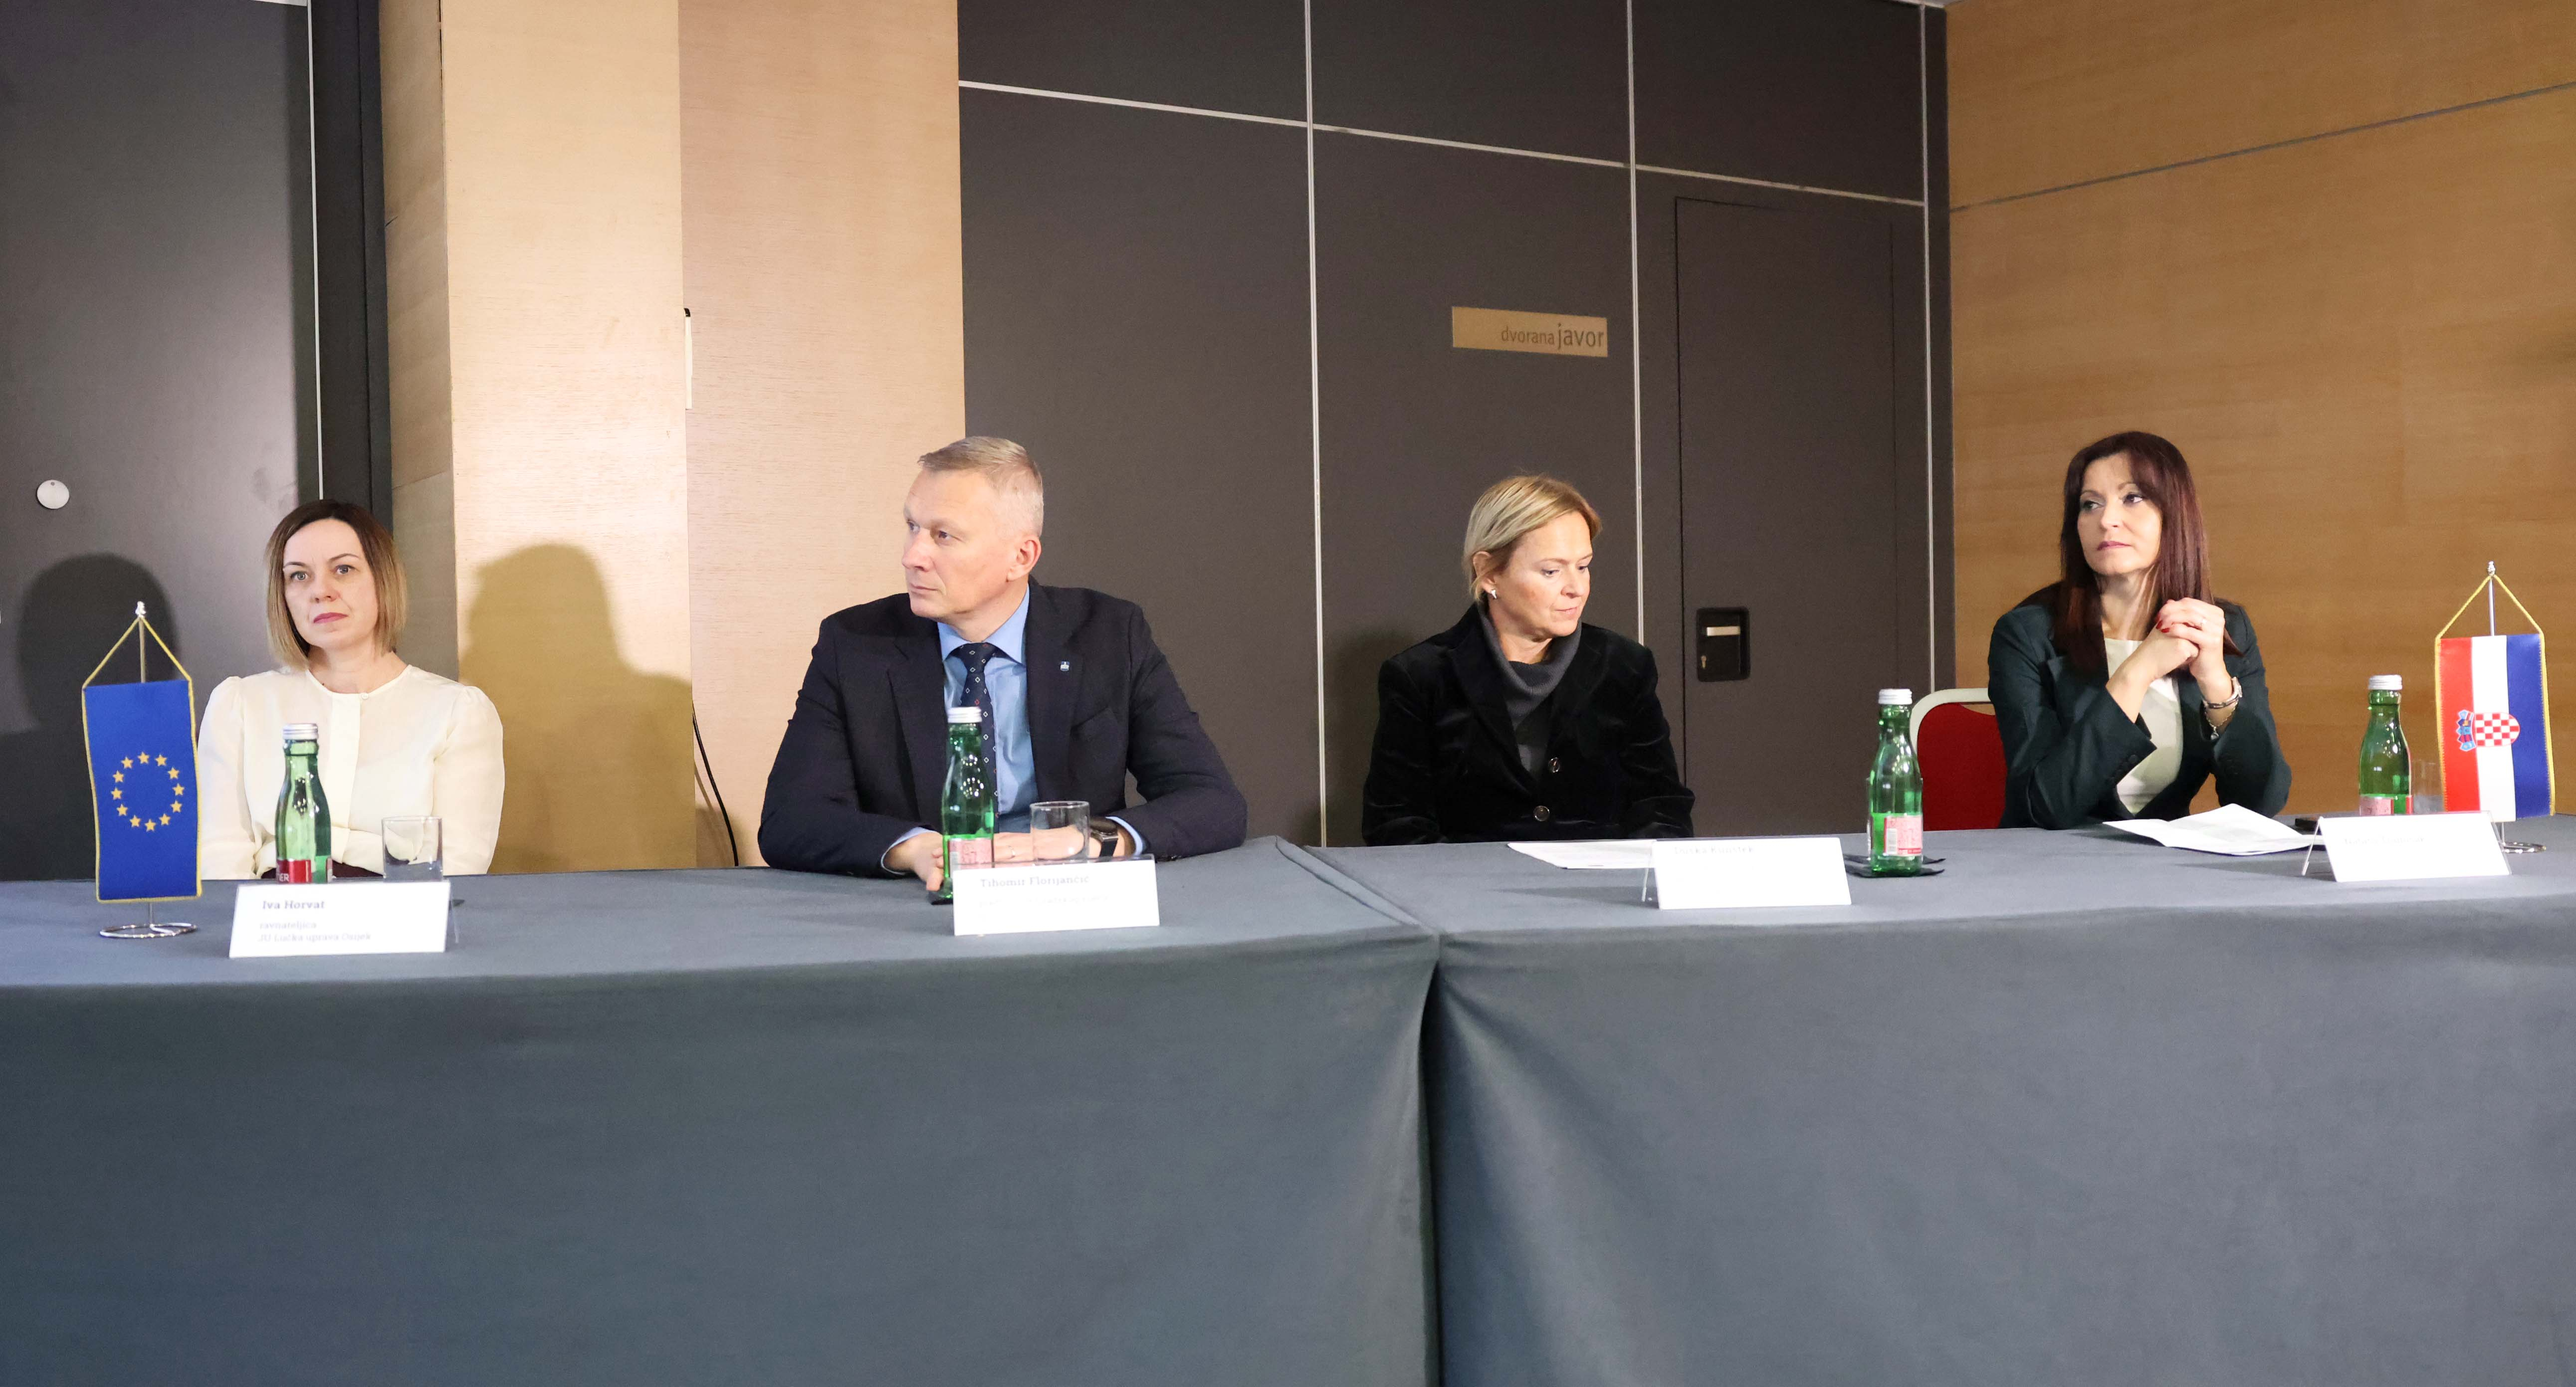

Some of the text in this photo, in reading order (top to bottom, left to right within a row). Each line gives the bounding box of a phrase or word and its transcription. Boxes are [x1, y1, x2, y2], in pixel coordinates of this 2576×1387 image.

[1501, 323, 1604, 349] dvorana javor
[980, 878, 1026, 887] Tihomir
[262, 900, 325, 909] Iva Horvat
